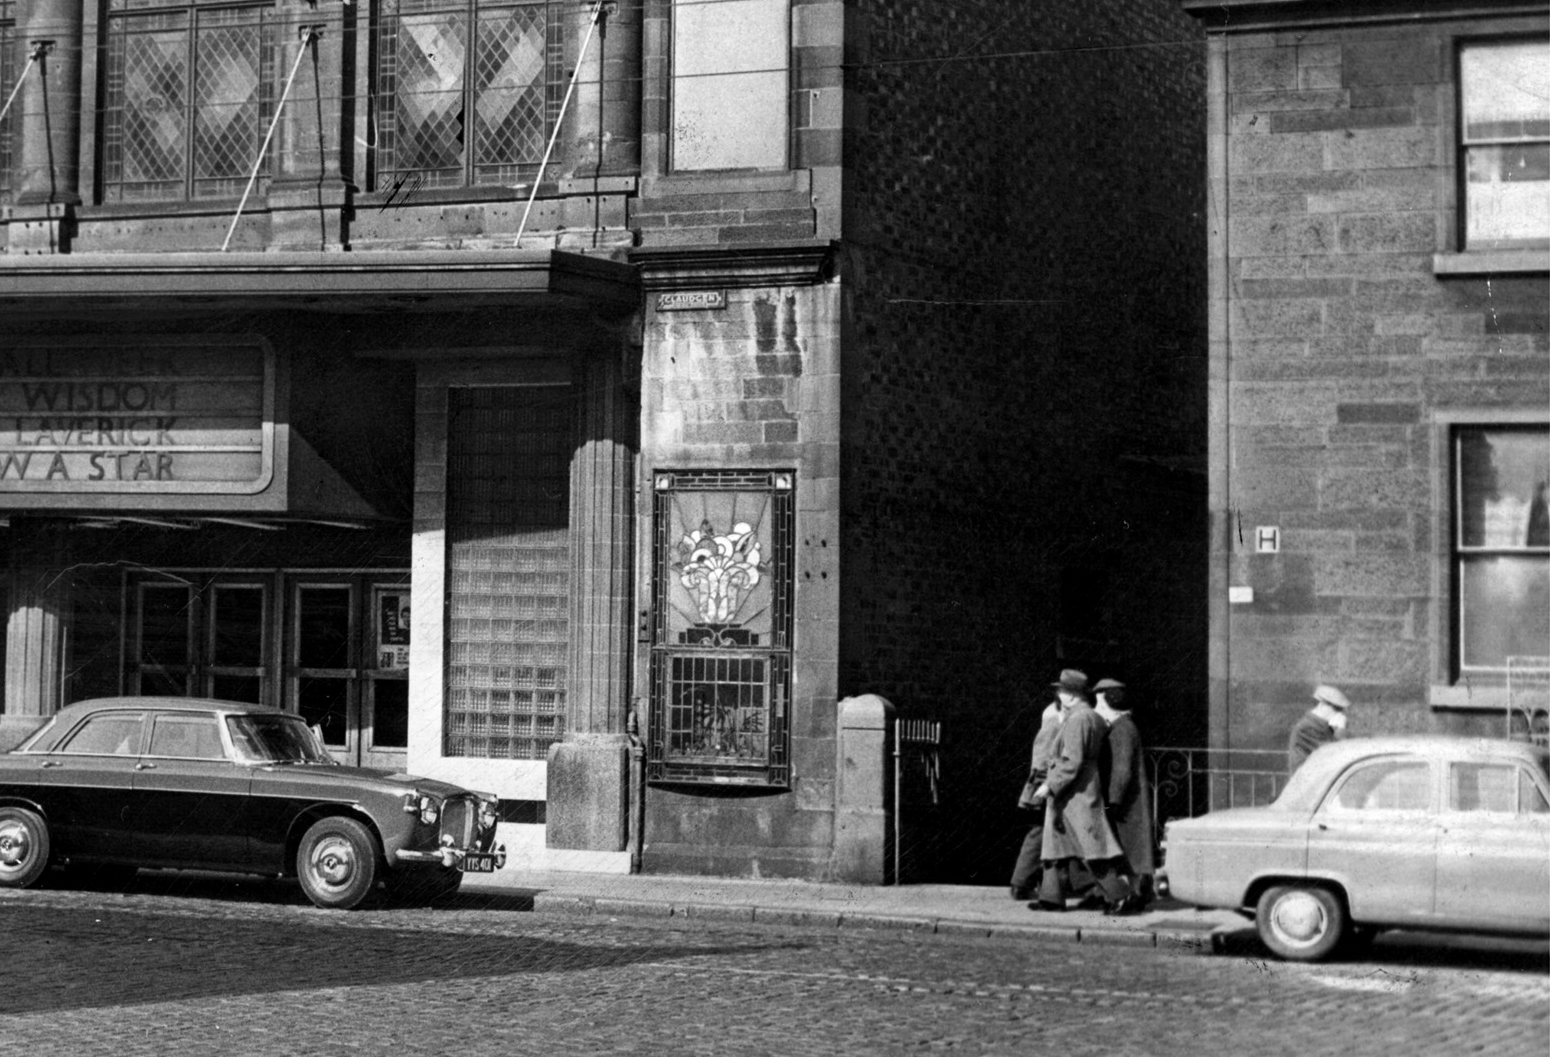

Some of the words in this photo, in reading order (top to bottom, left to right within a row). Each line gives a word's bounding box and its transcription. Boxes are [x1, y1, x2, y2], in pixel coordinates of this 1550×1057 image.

[23, 382, 178, 412] WISDOM
[16, 416, 179, 447] LAVERICK
[47, 452, 71, 481] A
[88, 452, 175, 481] STAR
[1258, 529, 1277, 550] H
